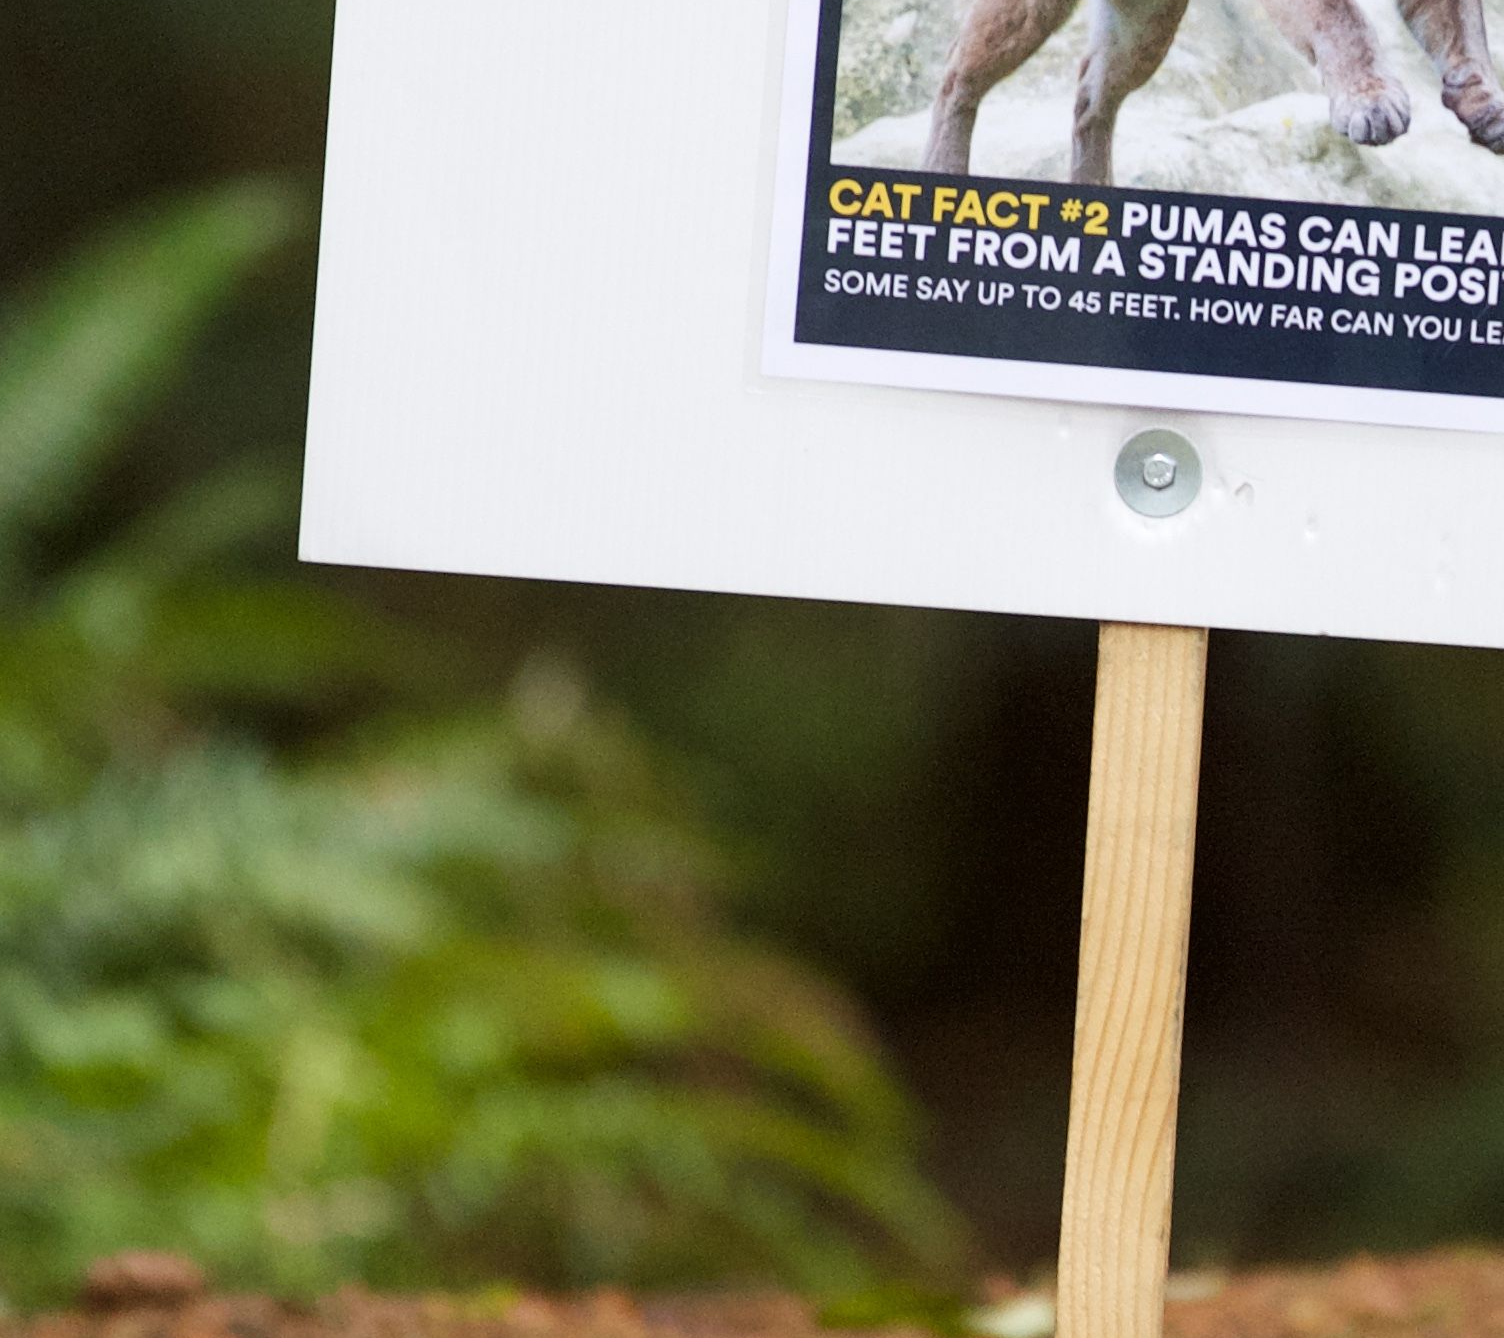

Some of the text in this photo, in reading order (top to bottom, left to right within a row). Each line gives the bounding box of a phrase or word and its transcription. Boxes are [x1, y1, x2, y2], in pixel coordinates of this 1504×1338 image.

[827, 218, 936, 260] FEET
[948, 228, 1080, 272] FROM
[1092, 240, 1125, 276] A
[1139, 243, 1380, 296] STANDING
[830, 180, 921, 219] CAT
[933, 188, 1049, 229] FACT
[1061, 199, 1108, 235] #2
[1122, 202, 1286, 249] PUMAS
[1299, 216, 1399, 258] CAN
[824, 269, 908, 298] SOME
[916, 276, 970, 302] SAY
[978, 281, 1014, 305] UP
[1022, 285, 1061, 310] TO
[1068, 291, 1101, 313] 45
[1109, 292, 1180, 319] FEET.
[1190, 298, 1263, 325] HOW
[1271, 304, 1323, 330] FAR
[1331, 309, 1394, 336] CAN
[1403, 315, 1461, 341] YOU
